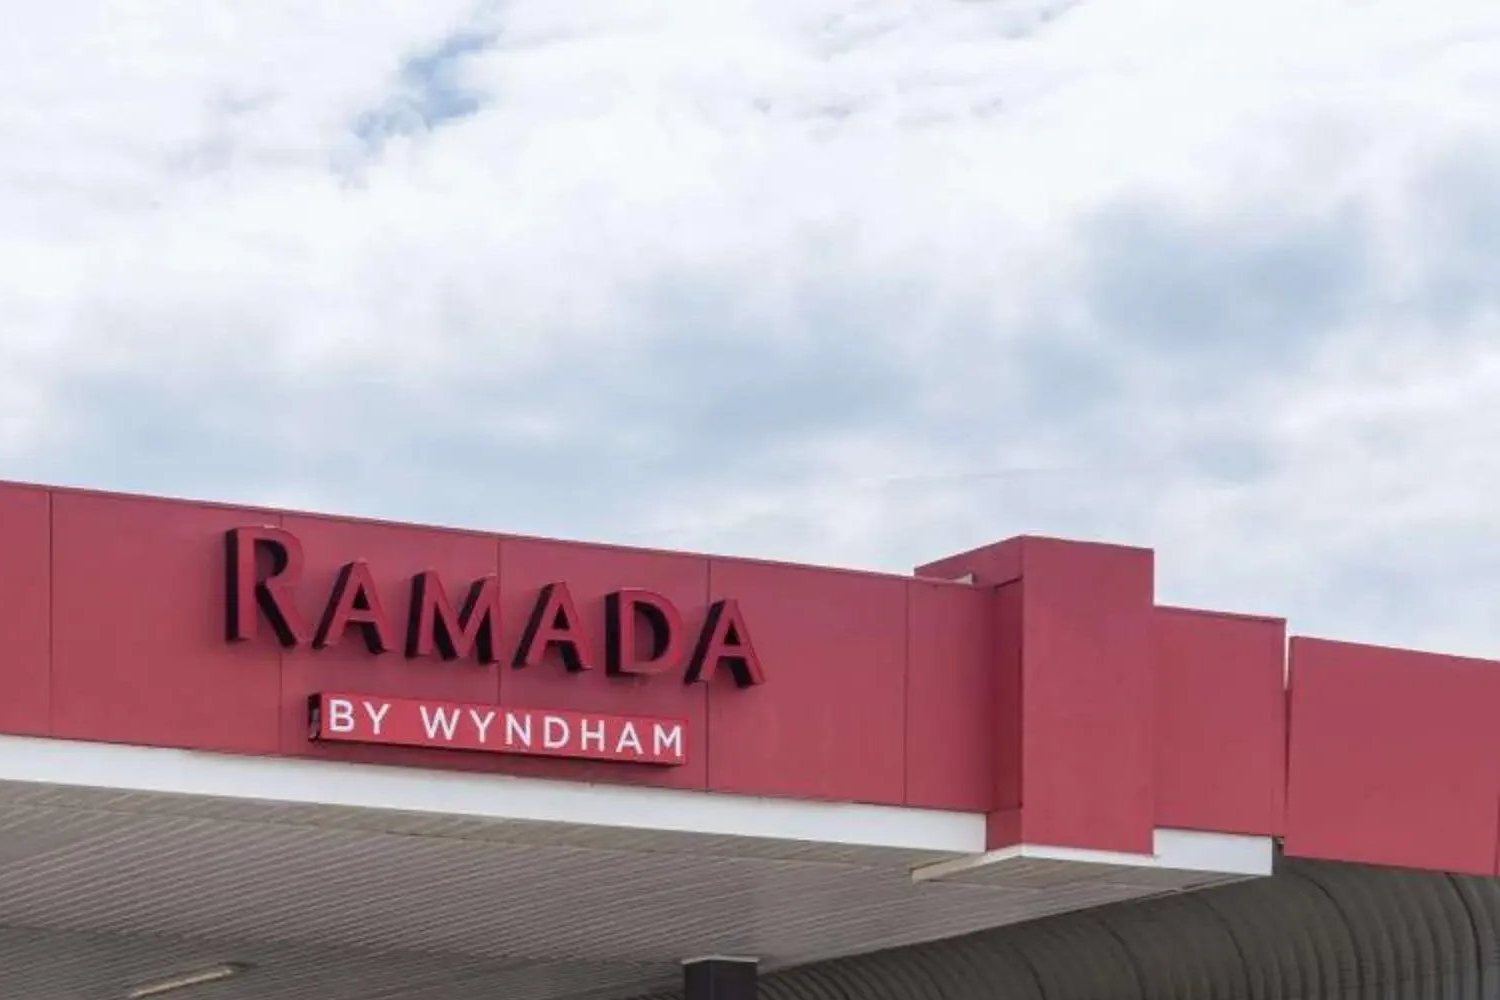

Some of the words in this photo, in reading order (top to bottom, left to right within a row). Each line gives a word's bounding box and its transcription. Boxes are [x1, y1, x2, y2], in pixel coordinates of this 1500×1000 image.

[225, 525, 765, 688] RAMADA
[329, 699, 391, 735] BY
[419, 705, 681, 757] WYNDHAM
